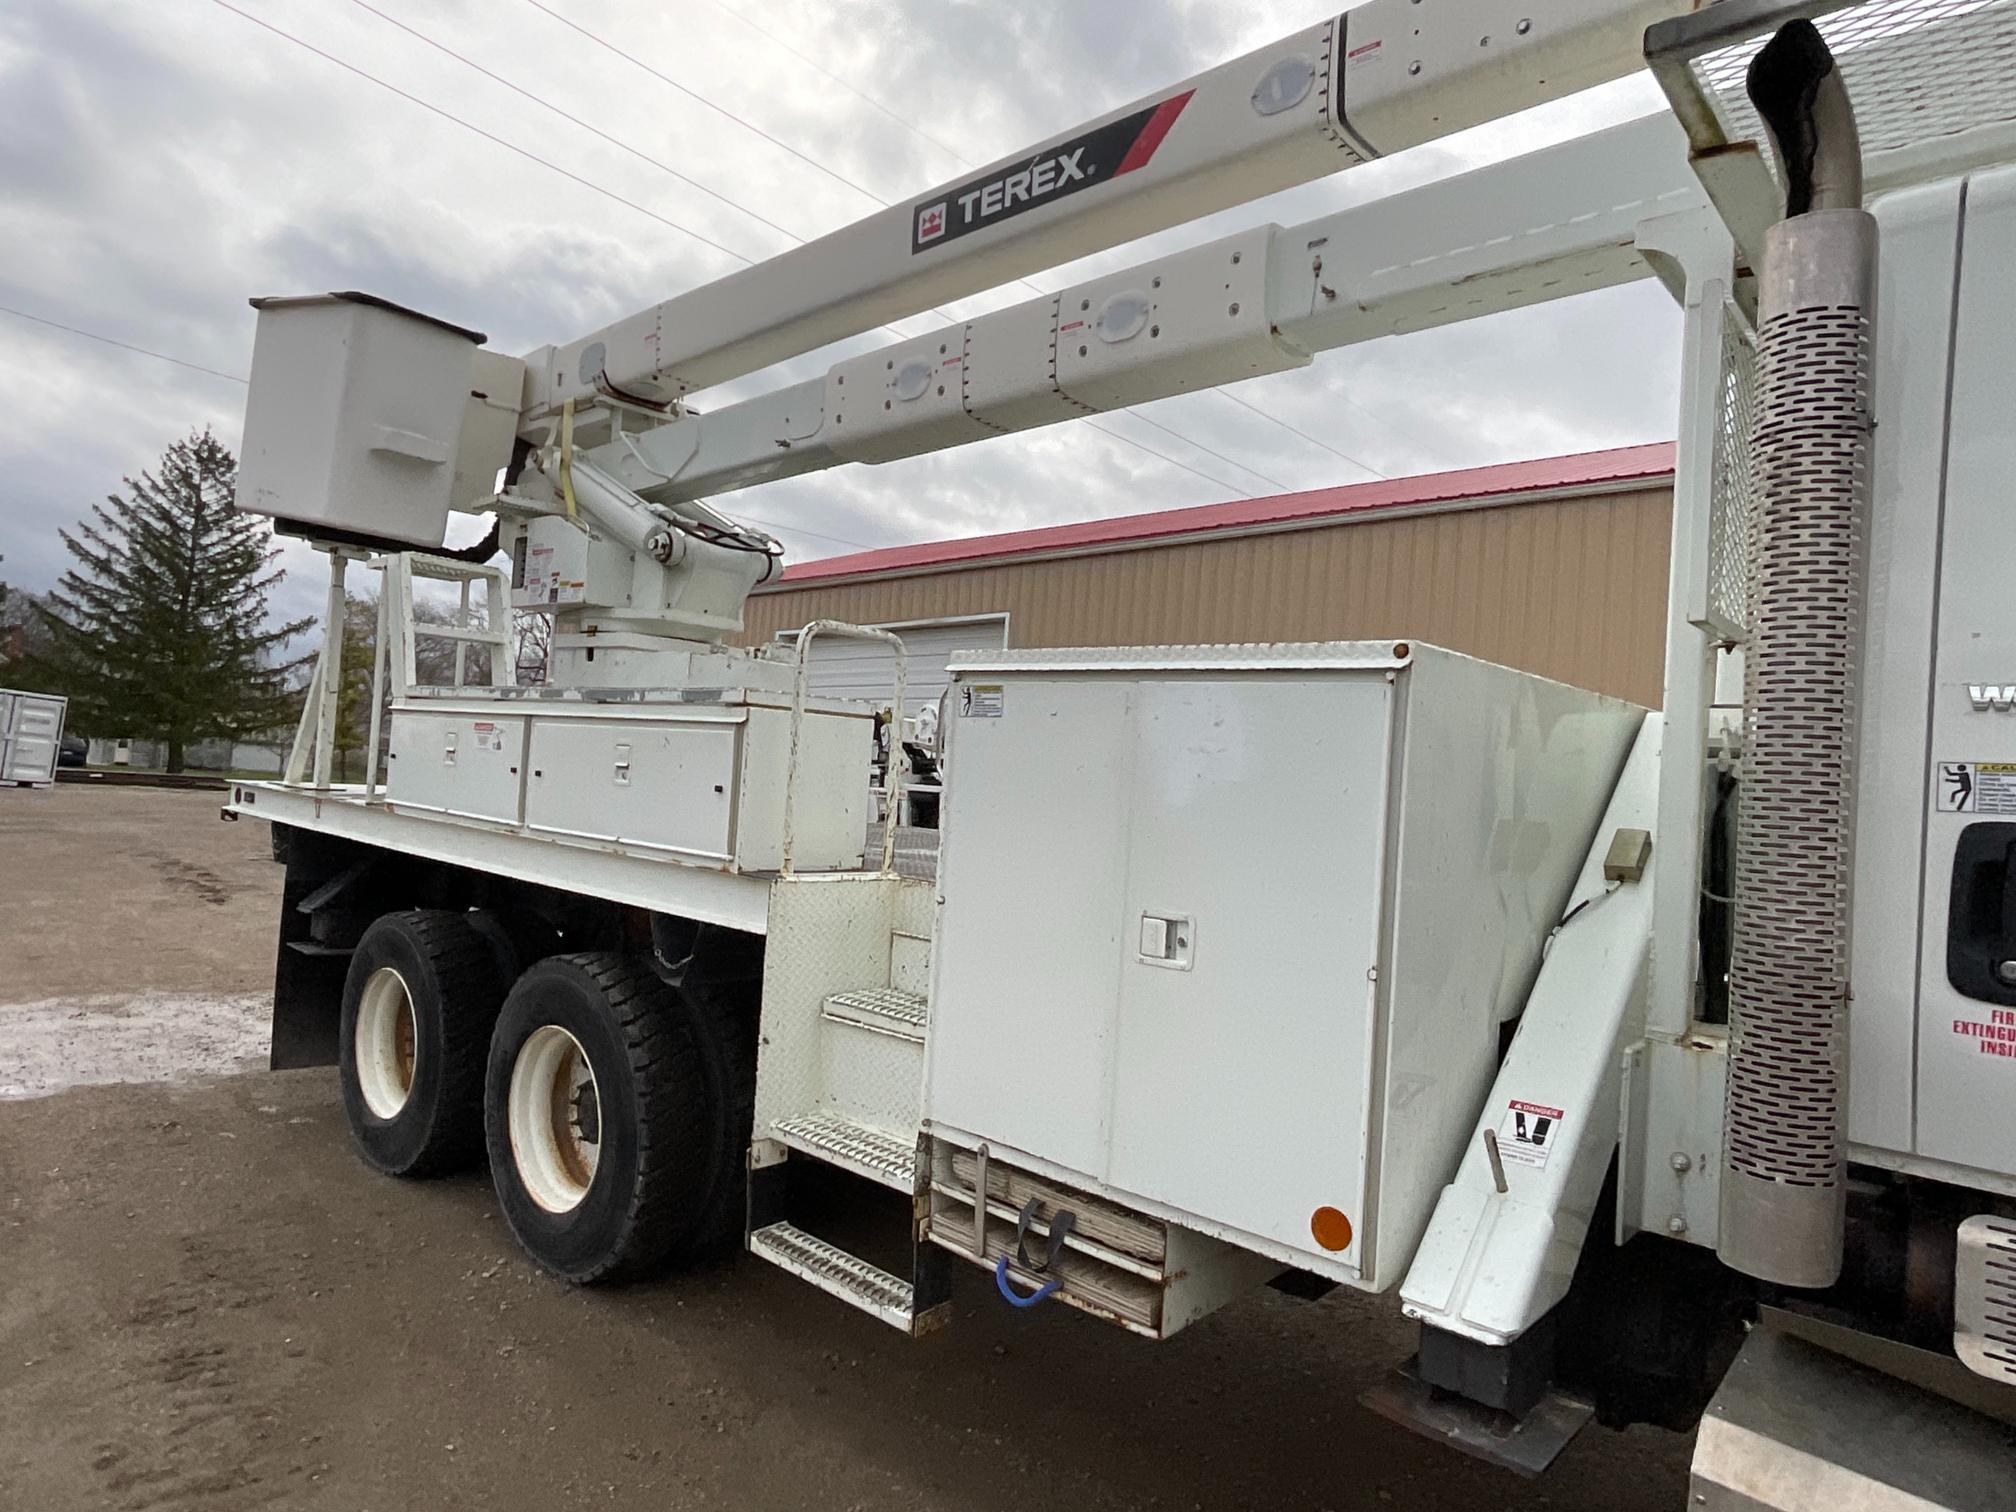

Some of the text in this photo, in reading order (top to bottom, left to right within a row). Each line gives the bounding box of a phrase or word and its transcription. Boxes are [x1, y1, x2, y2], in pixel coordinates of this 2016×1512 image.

[958, 146, 1086, 224] TEREX
[1968, 684, 2016, 711] W
[1981, 1041, 2016, 1058] INSI
